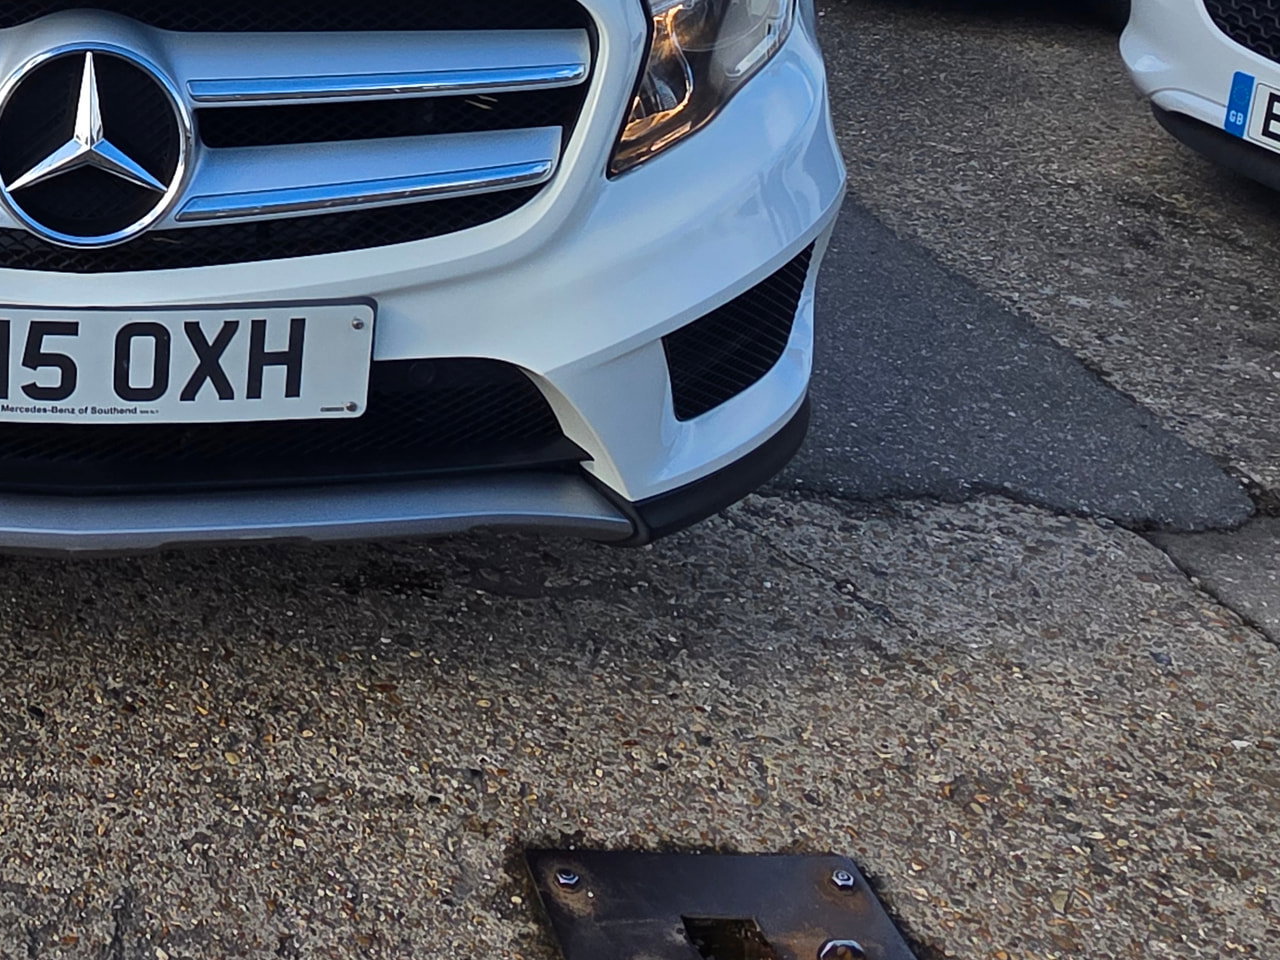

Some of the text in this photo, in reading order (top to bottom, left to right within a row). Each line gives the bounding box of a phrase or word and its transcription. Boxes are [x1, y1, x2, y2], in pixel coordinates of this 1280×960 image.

[1228, 109, 1244, 126] GB
[112, 317, 307, 403] OXH
[0, 404, 75, 415] Mercedes-Benz
[78, 405, 88, 415] of
[90, 406, 138, 415] Southend
